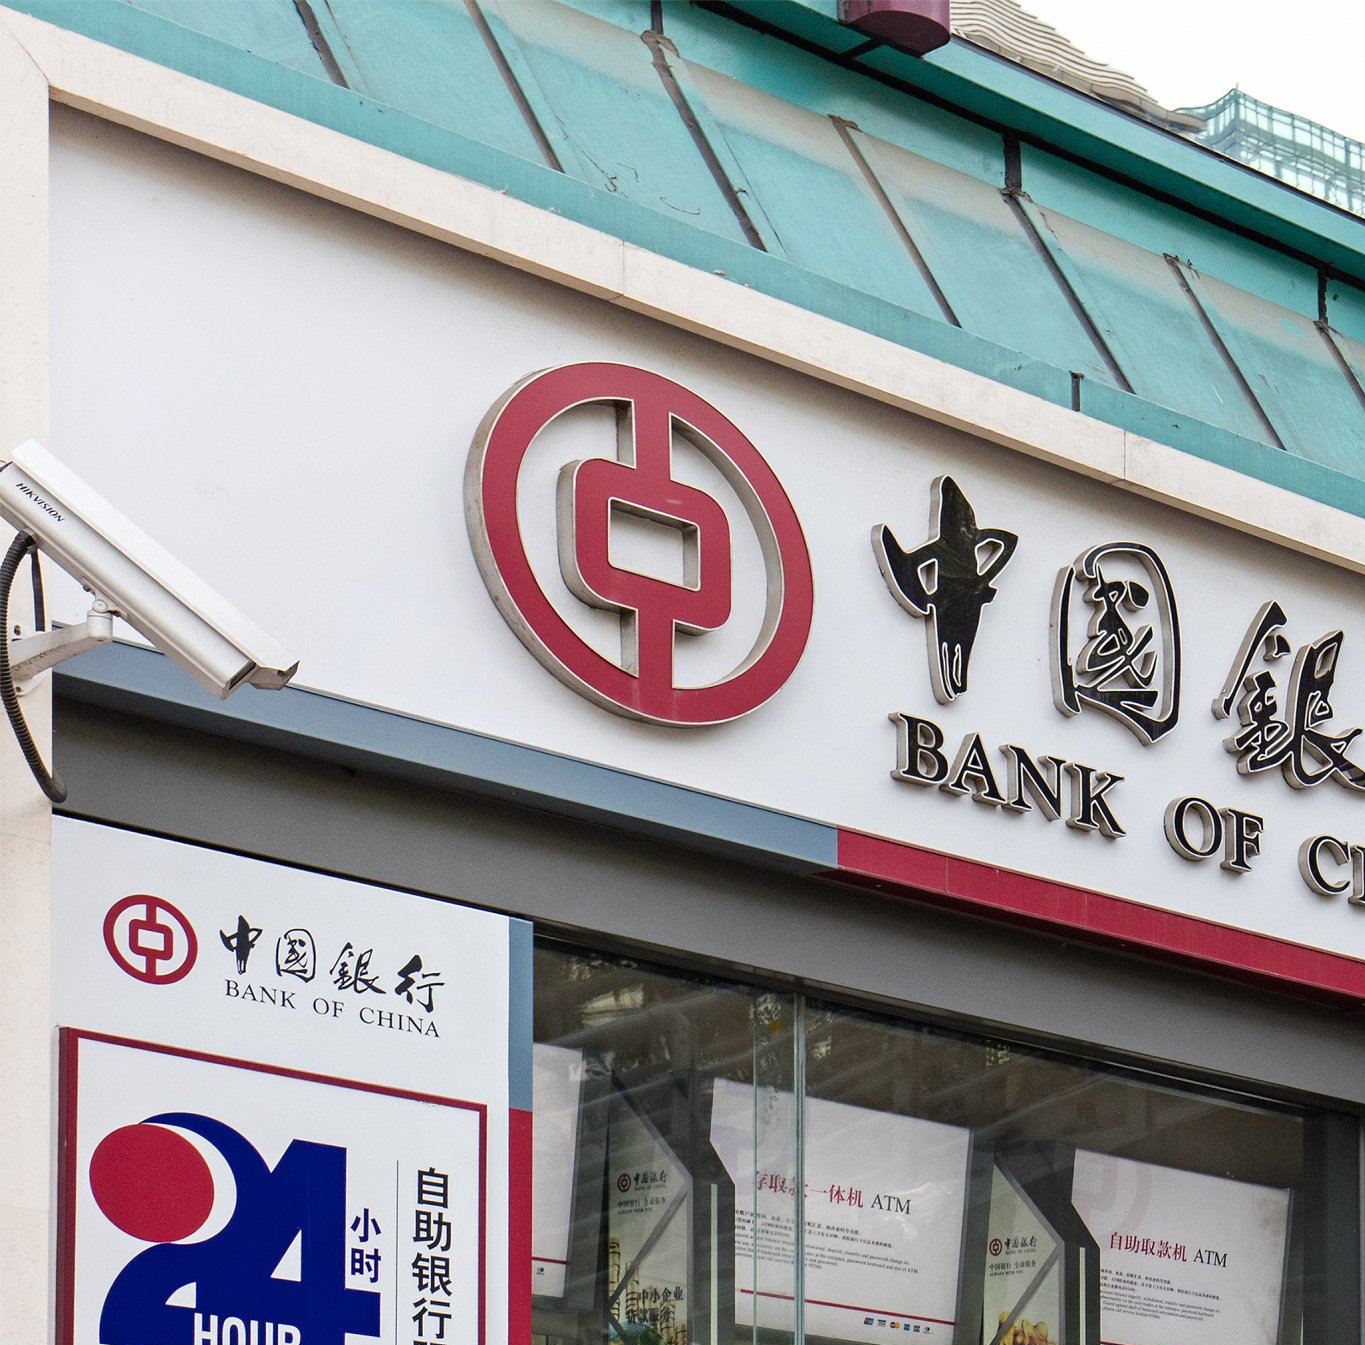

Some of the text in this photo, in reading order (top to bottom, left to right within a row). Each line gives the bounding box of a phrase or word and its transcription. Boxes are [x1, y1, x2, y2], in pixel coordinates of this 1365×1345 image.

[16, 482, 66, 522] HIKVISION
[890, 710, 1126, 840] BANK
[1164, 796, 1264, 876] OF
[224, 978, 441, 1039] BANK OF CHINA
[871, 1194, 912, 1215] ATM
[350, 1208, 381, 1284] 小时
[1110, 1232, 1228, 1268] 自助取款机 ATM
